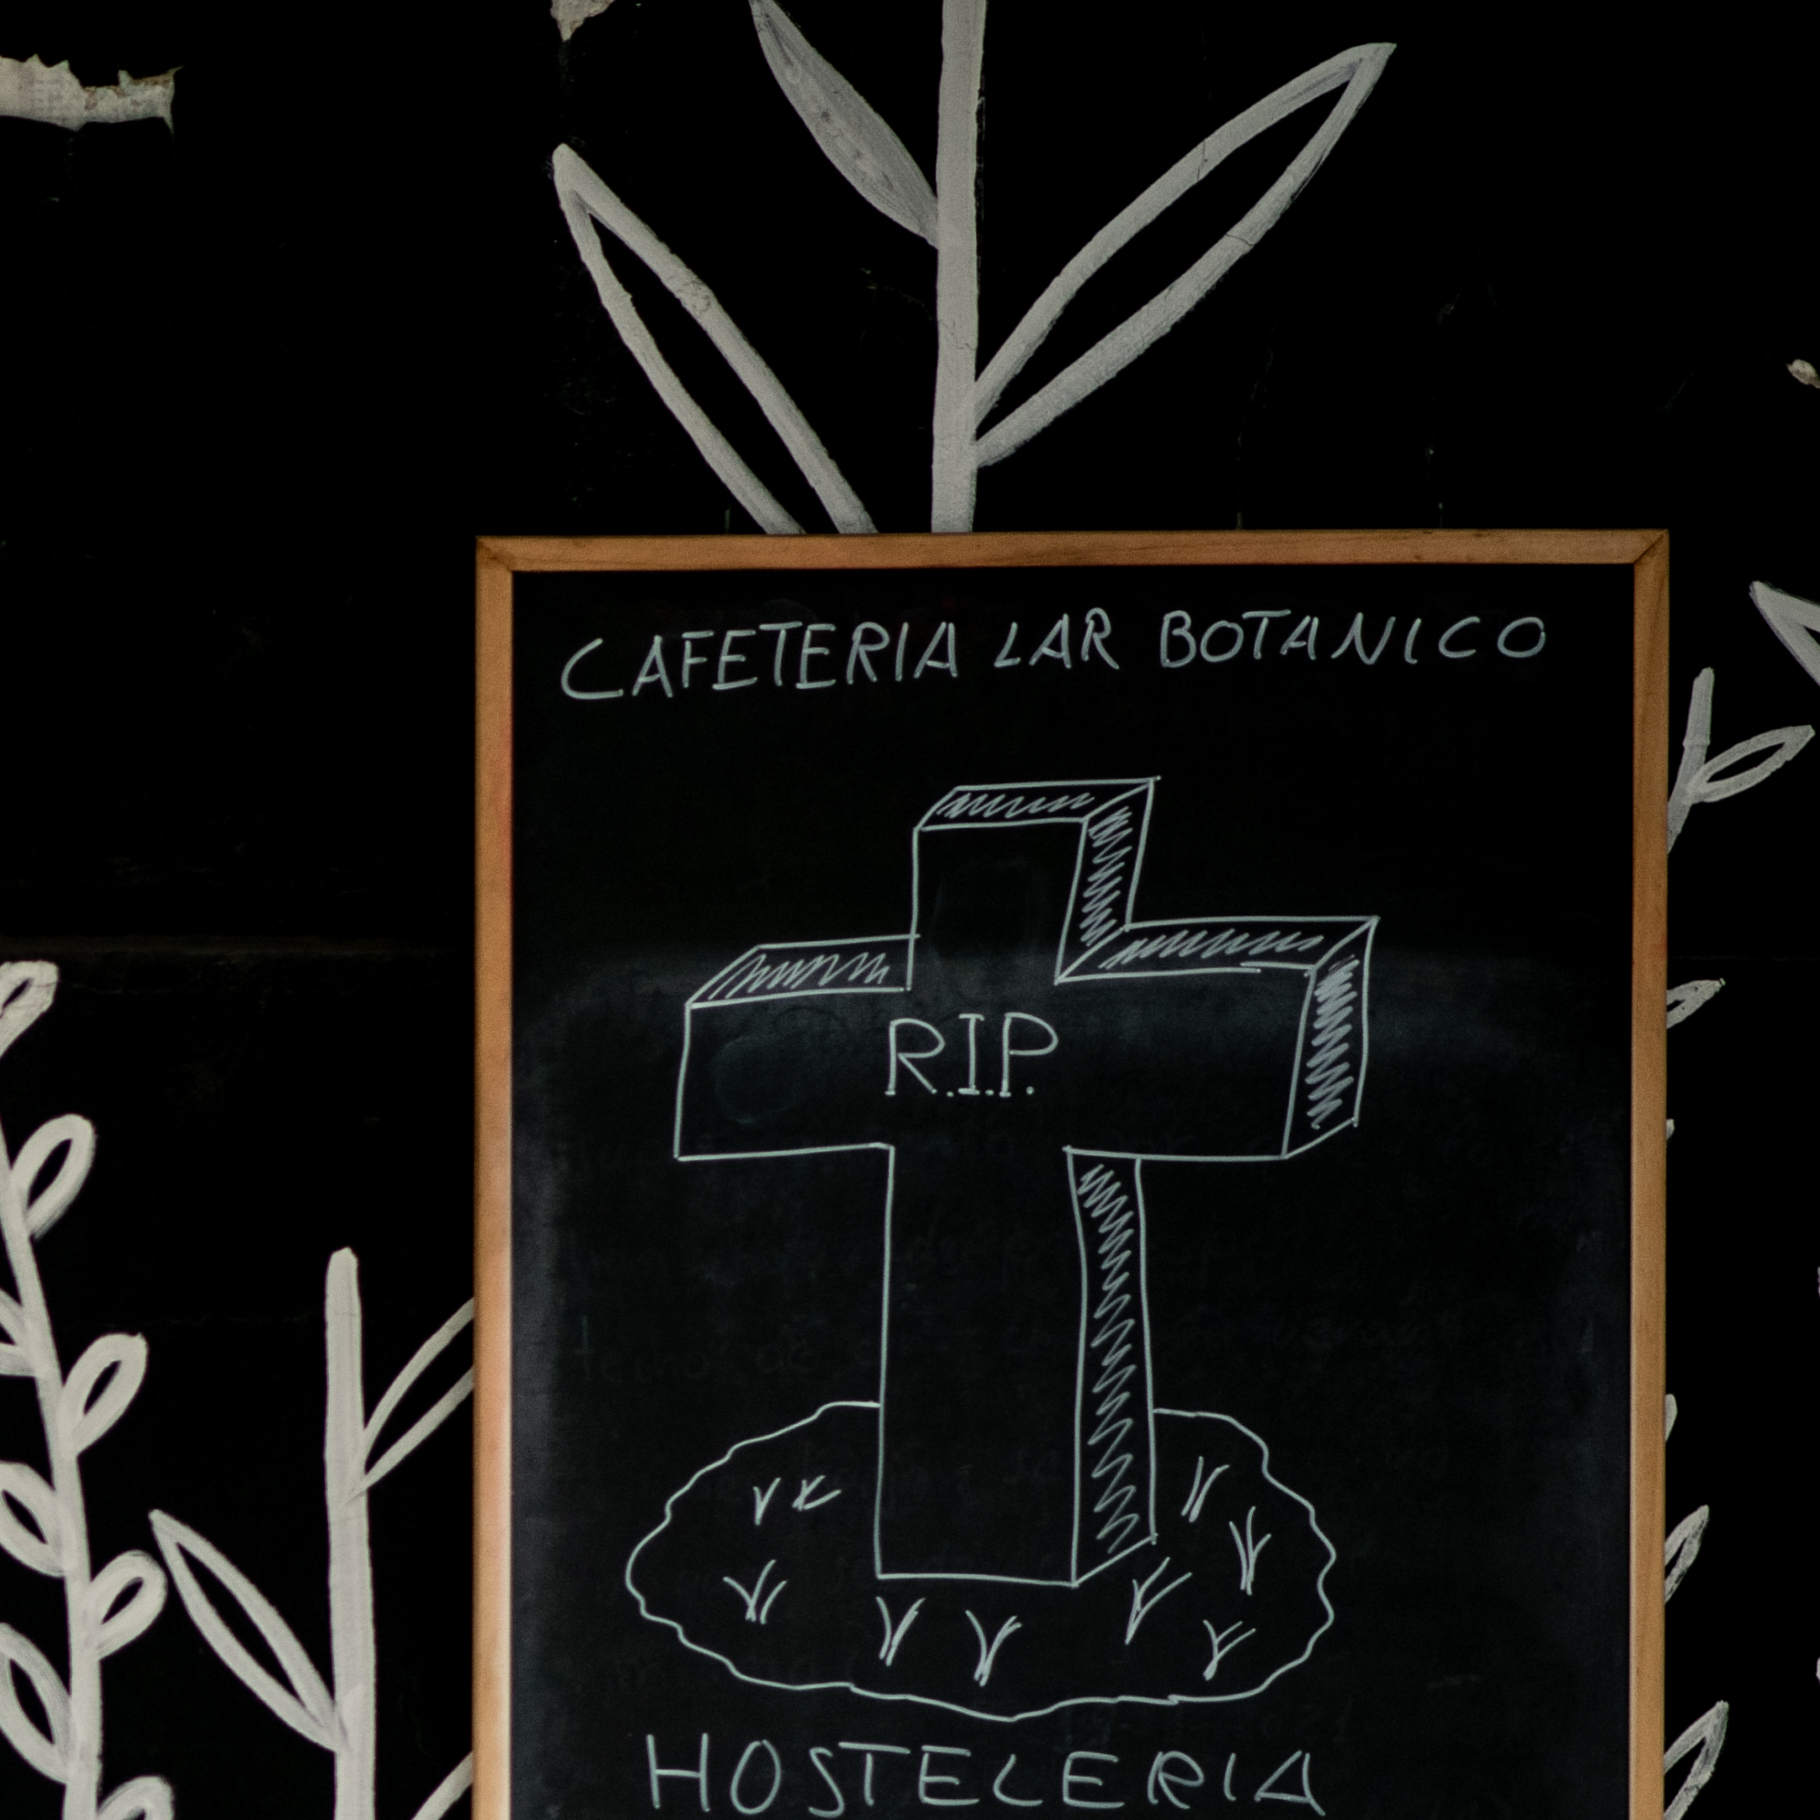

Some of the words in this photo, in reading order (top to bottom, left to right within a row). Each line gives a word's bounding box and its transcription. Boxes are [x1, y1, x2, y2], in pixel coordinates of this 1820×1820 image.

[560, 620, 958, 701] CAFETERIA
[993, 606, 1120, 670] LAR
[1159, 609, 1547, 669] BOTANICO
[645, 1731, 1326, 1818] HOSTELERIA
